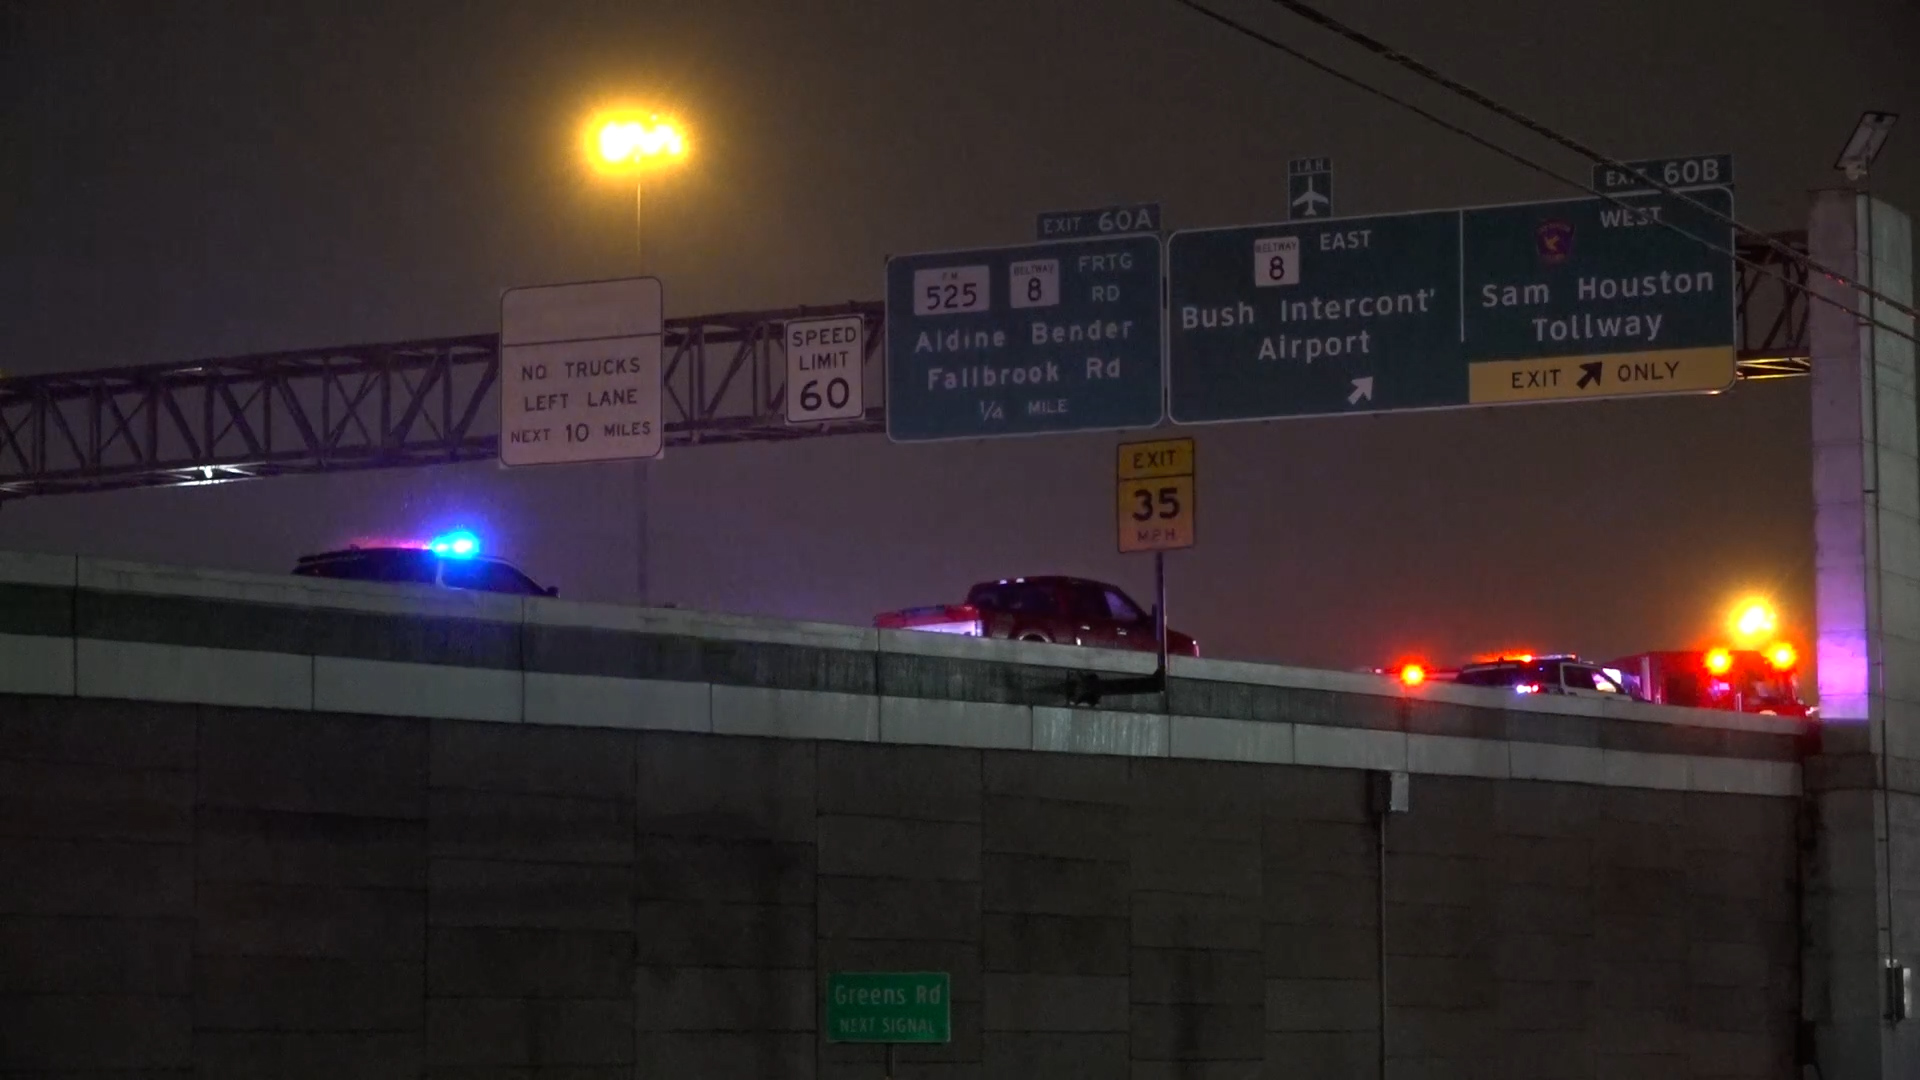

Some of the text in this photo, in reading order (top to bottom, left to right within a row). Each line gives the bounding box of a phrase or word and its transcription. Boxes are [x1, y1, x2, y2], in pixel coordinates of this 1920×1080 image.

[1297, 159, 1324, 172] IAH
[1606, 159, 1719, 187] EXT 60B
[1043, 209, 1152, 234] EXIT 60A
[1600, 206, 1662, 228] WEST
[1320, 230, 1372, 251] EAST
[1078, 253, 1133, 272] FRTG
[1269, 256, 1285, 280] 8
[927, 282, 977, 310] 525
[1028, 278, 1042, 302] 8
[1092, 285, 1120, 301] RD
[1482, 270, 1714, 308] Sam Houston
[1182, 301, 1254, 329] Bush
[792, 326, 857, 347] SPEED
[915, 319, 1132, 352] Aldine Bender
[1532, 313, 1662, 342] Tollway
[1258, 330, 1370, 363] Airport
[522, 357, 641, 380] NO TRUCKS
[799, 351, 849, 371] LIMIT
[928, 357, 1121, 391] Fallbrook Rd
[1512, 361, 1680, 389] EXIT ONLY
[524, 389, 638, 412] LEFT LANE
[800, 377, 850, 411] 60
[1028, 399, 1069, 415] MILE
[511, 422, 651, 443] NEXT 10 MILES
[1133, 449, 1177, 469] EXIT
[1132, 487, 1180, 522] 35
[835, 983, 942, 1005] Greens Rd
[840, 1017, 935, 1033] NEXT SIGNAL
